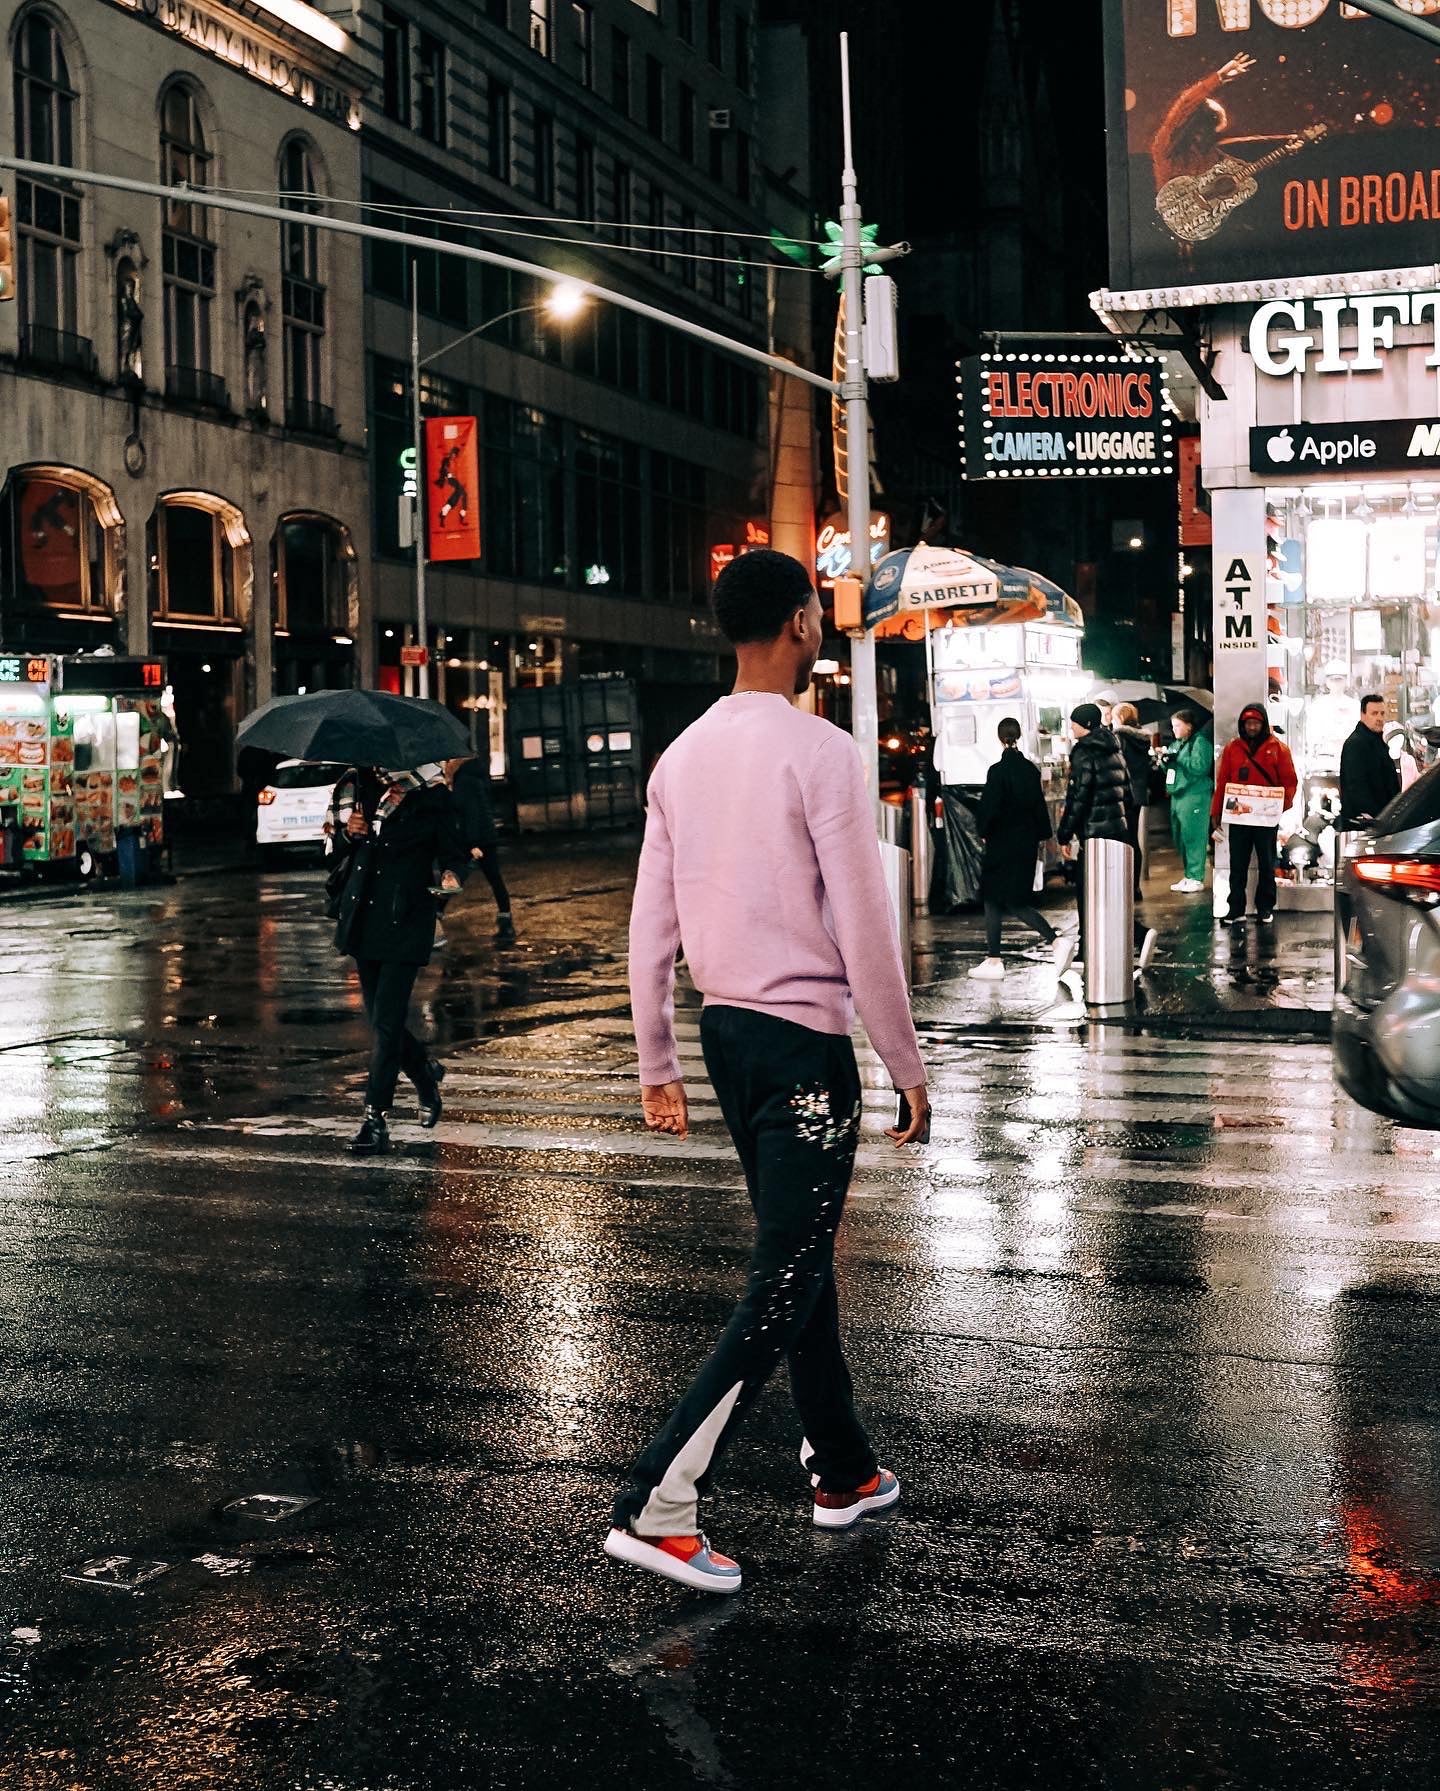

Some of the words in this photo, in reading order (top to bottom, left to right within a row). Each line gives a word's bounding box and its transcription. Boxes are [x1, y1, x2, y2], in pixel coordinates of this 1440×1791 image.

[1284, 178, 1329, 230] ON
[988, 372, 1153, 418] ELECTRONICS
[991, 432, 1067, 461] CAMERA
[1075, 432, 1156, 460] LUGGAGE
[1300, 434, 1377, 465] Apple
[910, 583, 993, 605] SABRETT
[1224, 559, 1252, 638] ATM
[1219, 641, 1259, 649] INSIDE
